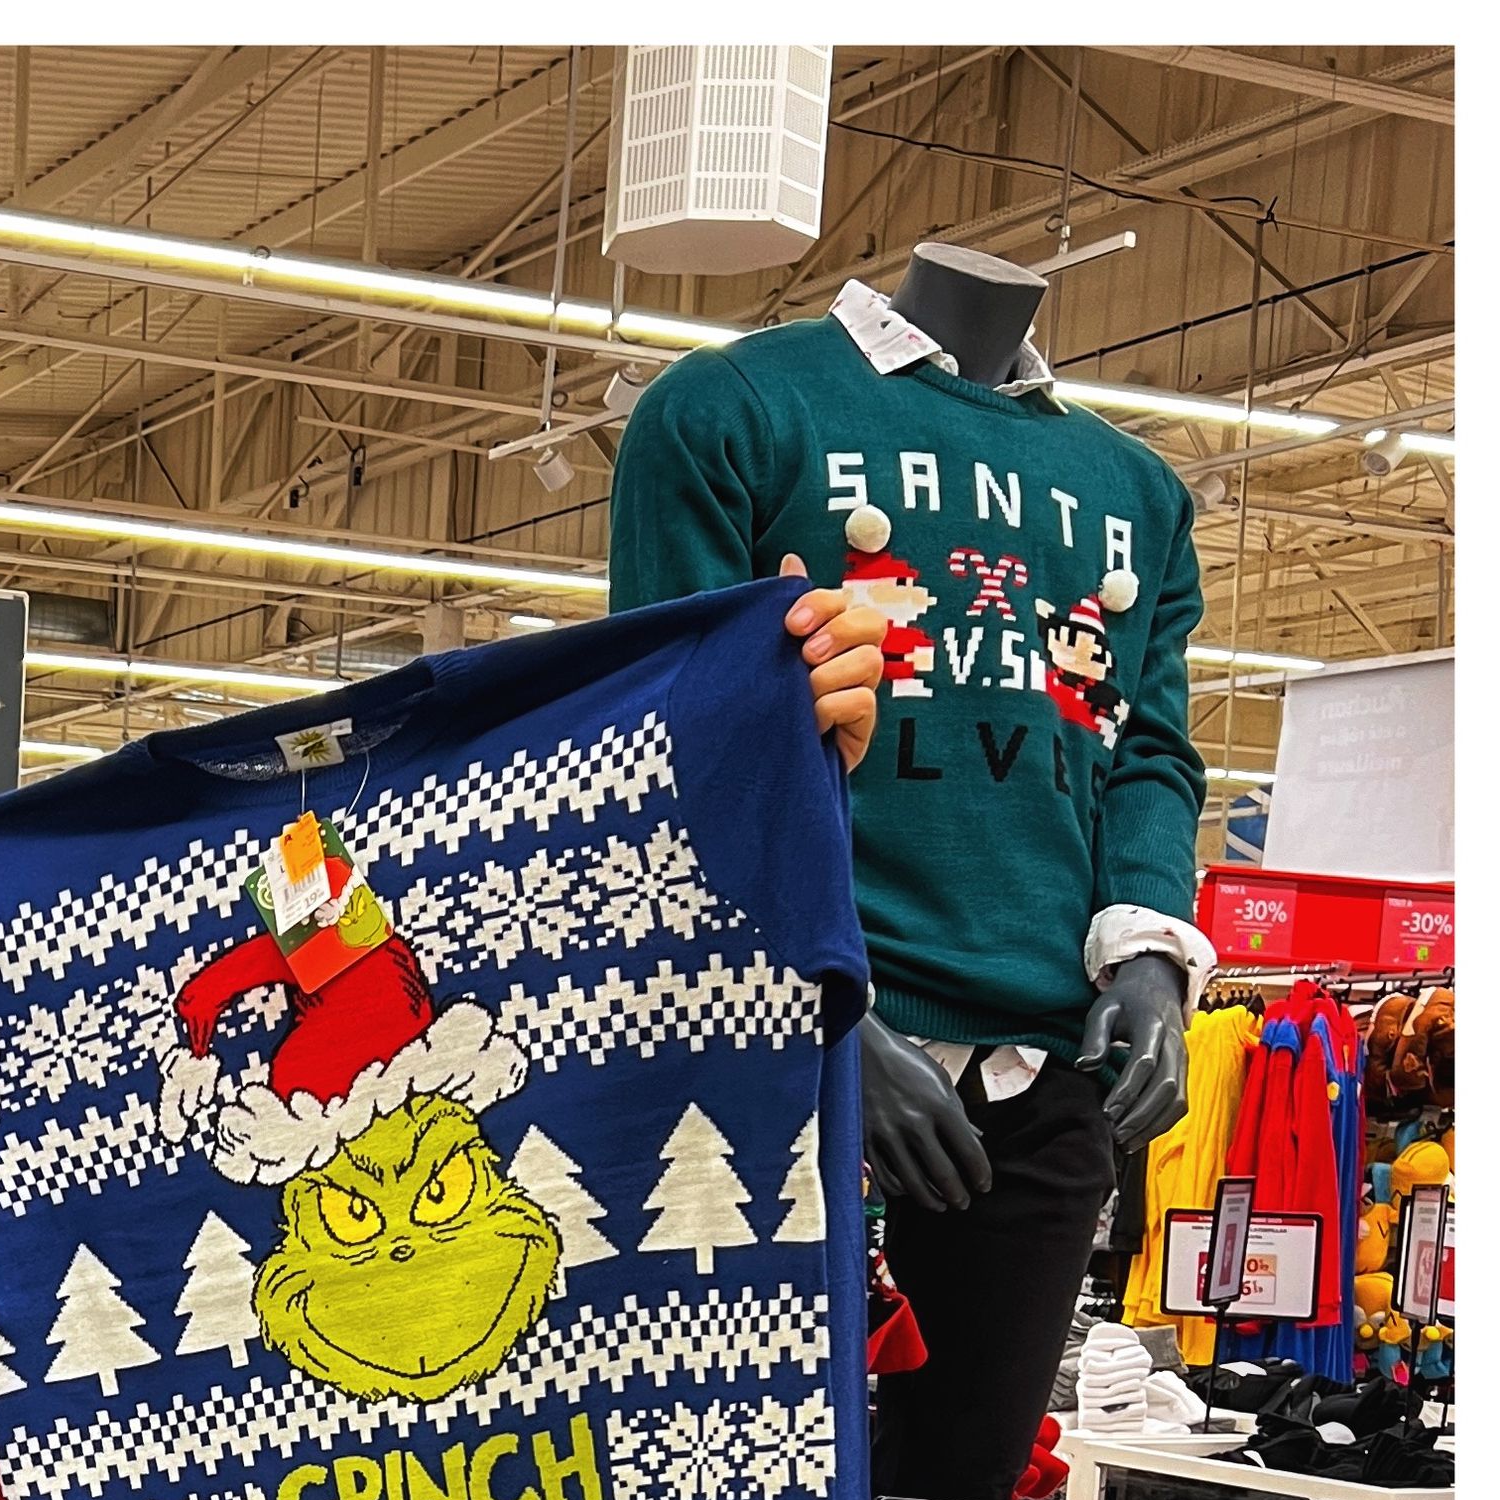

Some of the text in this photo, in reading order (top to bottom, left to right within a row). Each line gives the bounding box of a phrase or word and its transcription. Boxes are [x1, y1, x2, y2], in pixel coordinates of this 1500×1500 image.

[826, 450, 1133, 572] SANTA
[1234, 899, 1288, 924] -30%
[1401, 912, 1453, 936] -30%
